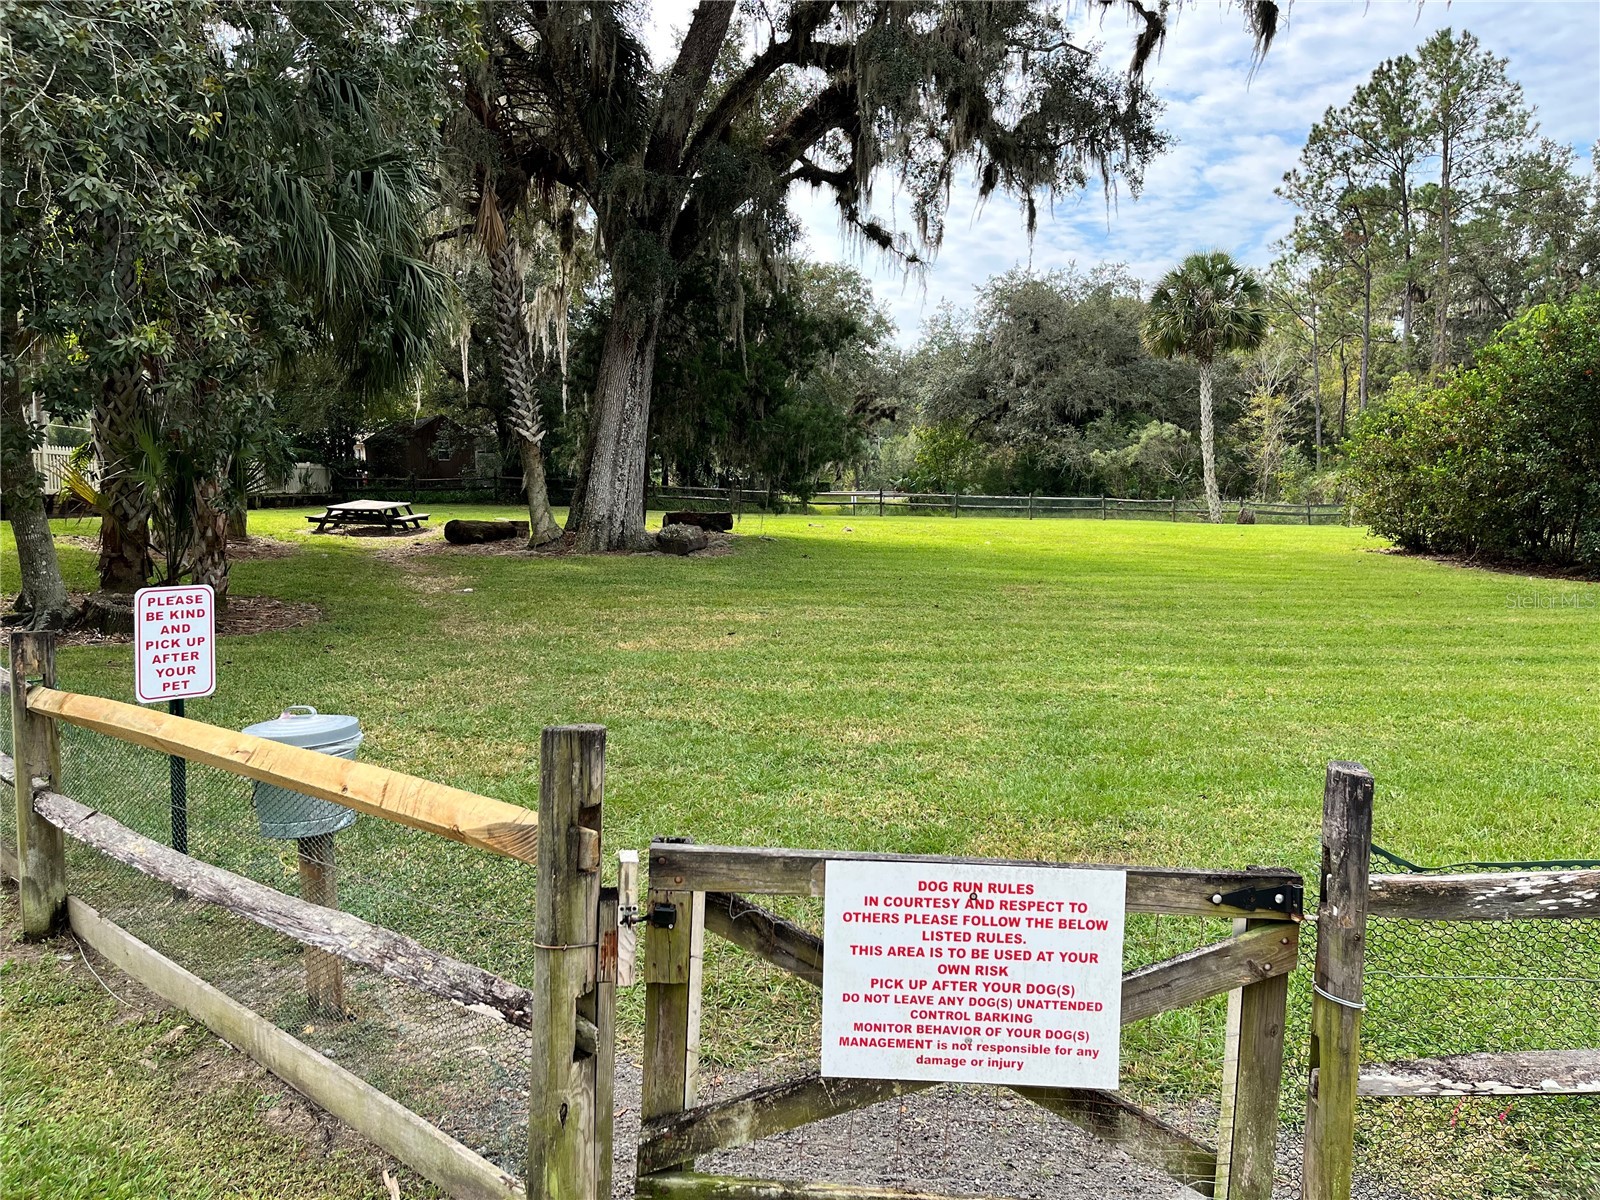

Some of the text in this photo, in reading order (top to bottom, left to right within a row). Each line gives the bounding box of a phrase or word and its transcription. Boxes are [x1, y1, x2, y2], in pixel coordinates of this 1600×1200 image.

[147, 594, 204, 607] PLEASE
[145, 608, 206, 621] BE KIND
[160, 623, 191, 635] AND
[145, 636, 206, 651] PICK UP
[152, 651, 200, 664] AFTER
[156, 665, 196, 678] YOUR
[162, 680, 190, 692] PET
[917, 880, 1035, 896] DOG RUN RULES
[863, 896, 1089, 914] IN COURTESY AND RESPECT TO
[842, 912, 1109, 932] OTHERS PLEASE FOLLOW THE BELOW
[921, 931, 1027, 945] LISTED RULES.
[849, 945, 1099, 964] THIS AREA IS TO BE USED AT YOUR
[936, 964, 1009, 977] OWN RISK
[870, 978, 1076, 998] PICK UP AFTER YOUR DOG(S)
[841, 993, 1104, 1013] DO NOT LEAVE ANY DOG(S) UNATTENDED
[909, 1010, 1033, 1025] CONTROL BARKING
[853, 1022, 1090, 1044] MONITOR BEHAVIOR OF YOUR DOG(S)
[838, 1036, 1099, 1060] MANAGEMENT is not responsible for any
[915, 1056, 1024, 1071] damage or injury
